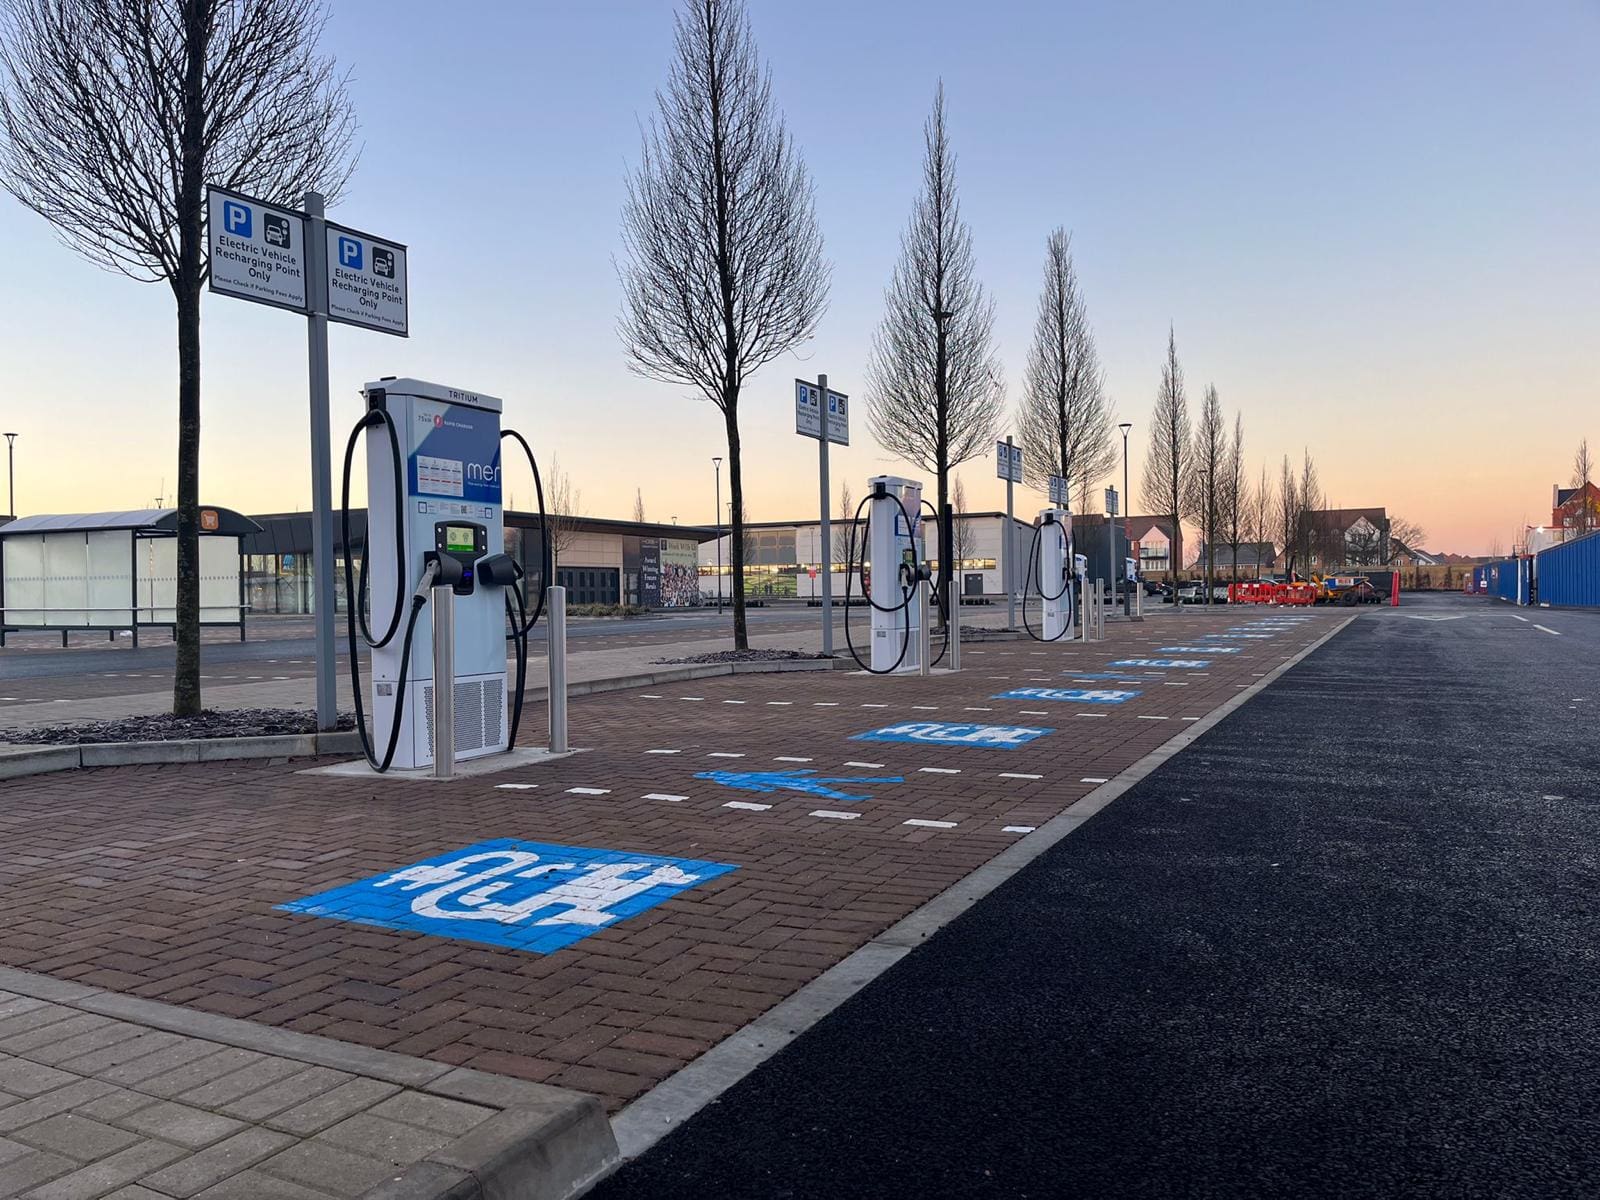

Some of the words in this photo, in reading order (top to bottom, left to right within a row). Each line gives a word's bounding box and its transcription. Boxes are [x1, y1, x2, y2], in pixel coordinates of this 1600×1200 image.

[230, 206, 246, 231] P
[215, 246, 272, 271] Recharging
[275, 262, 301, 277] Point
[219, 235, 259, 254] Electric
[261, 247, 296, 264] Vehicle
[343, 240, 358, 264] P
[248, 267, 271, 282] Only
[335, 268, 368, 284] Electric
[370, 278, 399, 293] Vehicle
[214, 274, 232, 283] Please
[232, 279, 249, 287] Check
[255, 284, 274, 295] Parking
[275, 289, 287, 297] Fees
[288, 293, 303, 302] Apply
[332, 278, 379, 299] Recharging
[381, 292, 403, 304] Point
[346, 307, 360, 315] Check
[364, 312, 381, 322] Parking
[359, 296, 378, 310] Only
[448, 390, 479, 403] TRITIUM
[467, 462, 500, 482] mer
